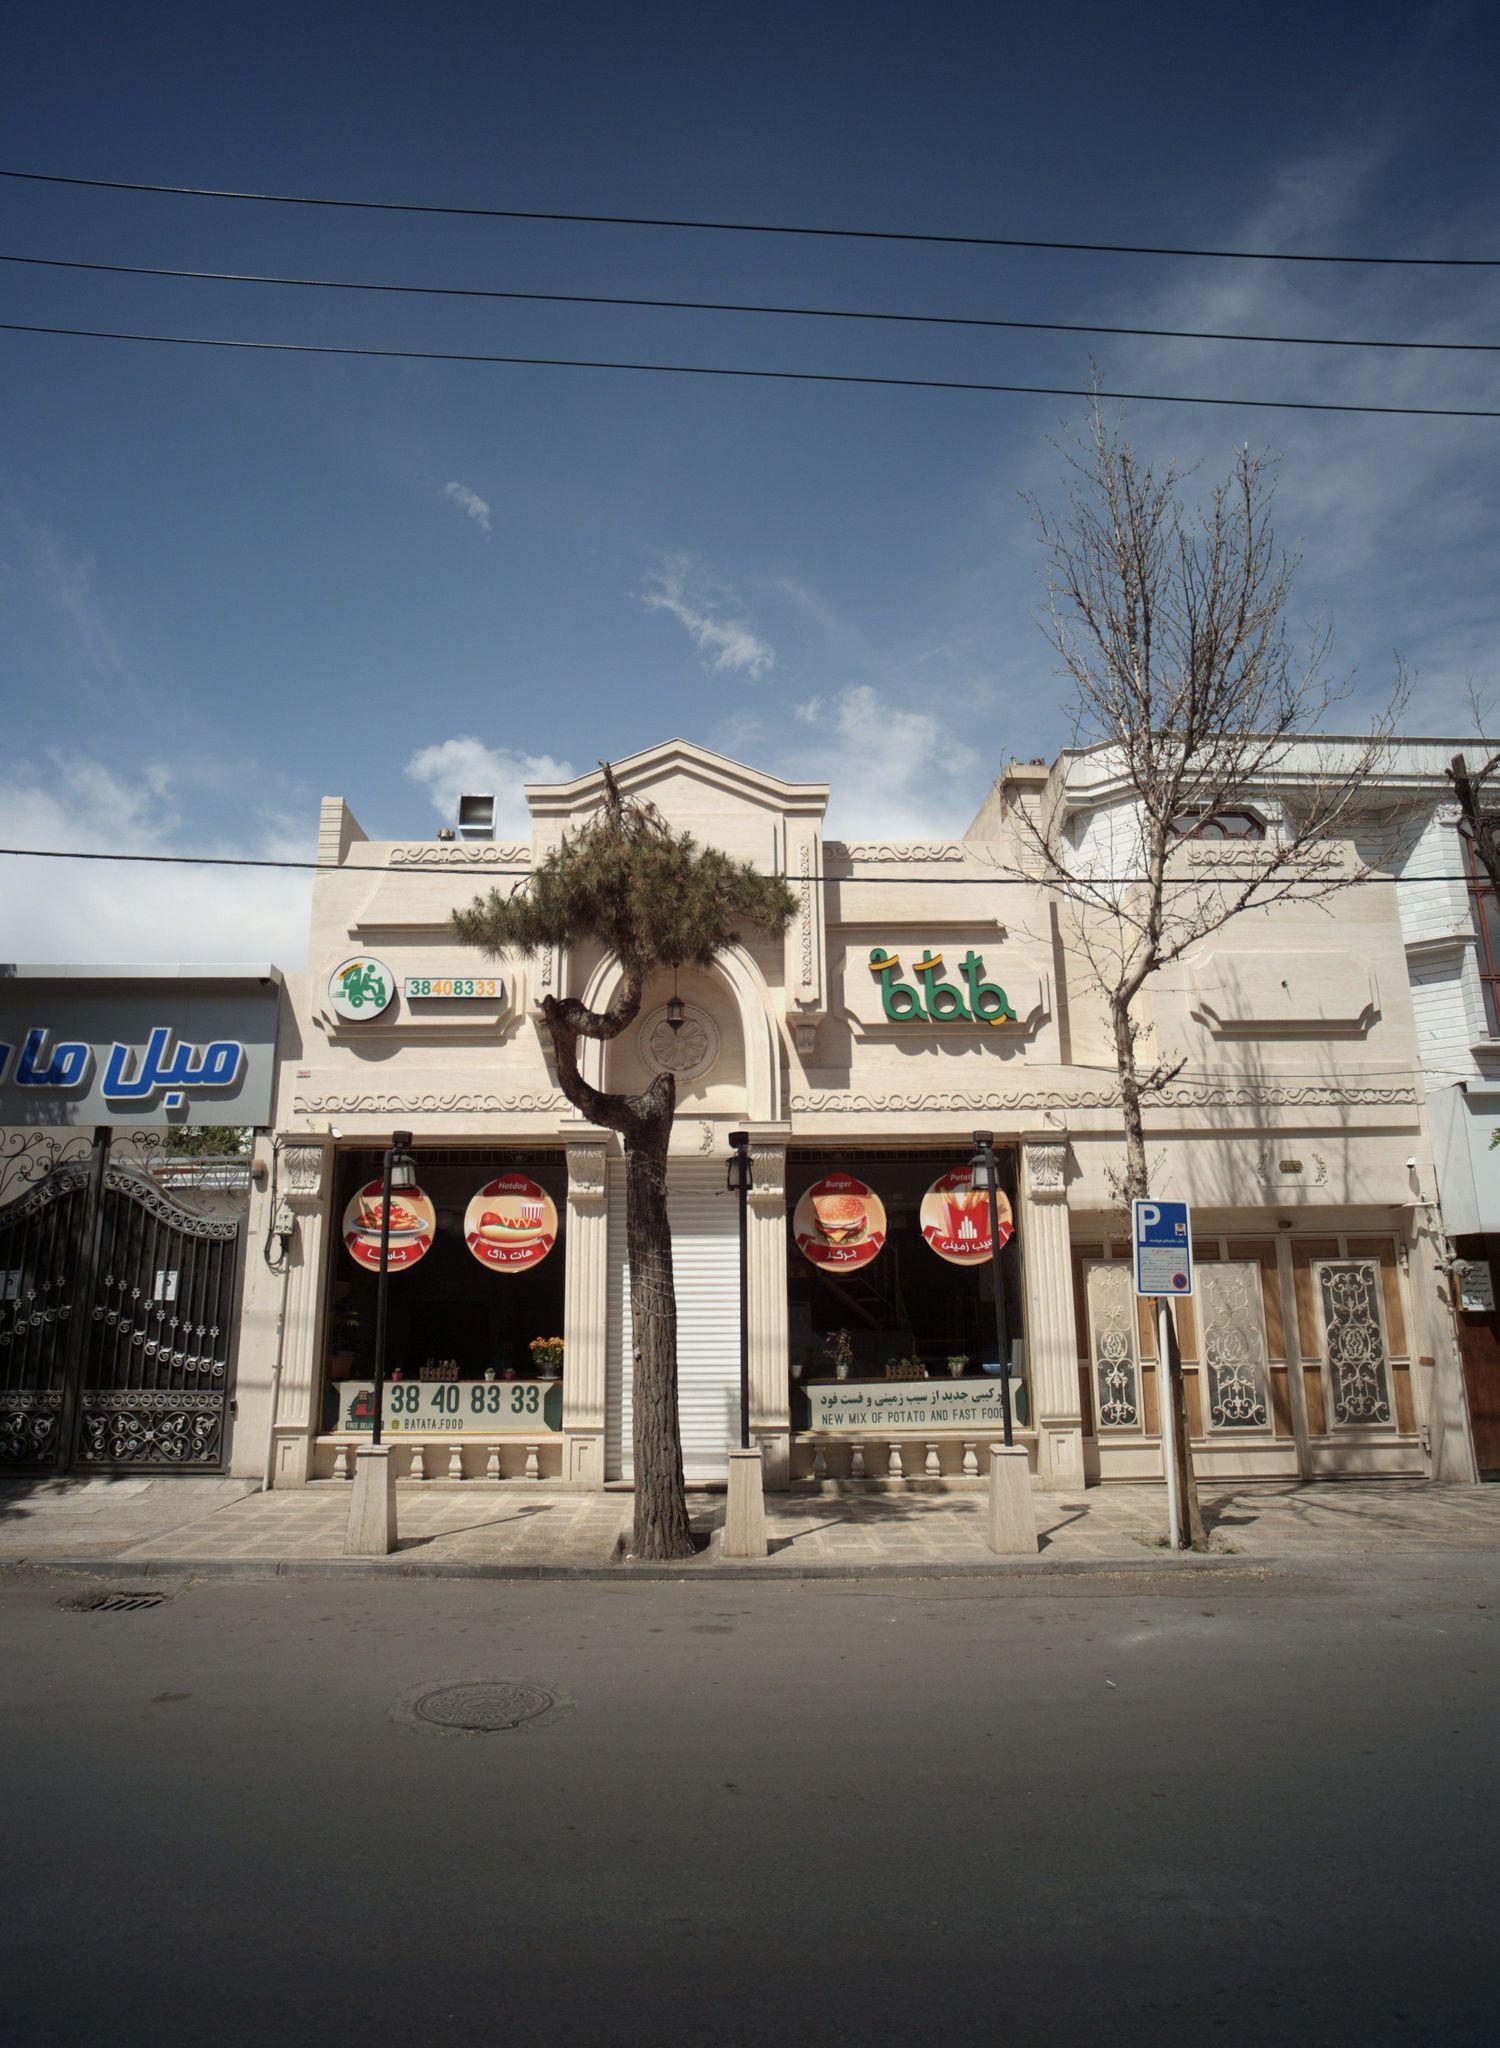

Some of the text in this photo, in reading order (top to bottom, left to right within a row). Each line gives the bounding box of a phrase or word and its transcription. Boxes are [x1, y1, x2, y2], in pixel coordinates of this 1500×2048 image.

[410, 980, 497, 996] 38408333
[102, 1027, 242, 1109] مبل
[498, 1181, 528, 1192] Hotdog
[825, 1179, 852, 1190] Burger
[1137, 1204, 1161, 1243] P
[941, 1240, 970, 1252] زمینی
[510, 1249, 533, 1260] هات
[391, 1384, 539, 1413] 38 40 83 33
[821, 1392, 838, 1408] فود
[840, 1392, 863, 1405] فست
[866, 1396, 872, 1407] و
[875, 1393, 904, 1406] زمینی
[906, 1393, 928, 1405] سیب
[930, 1390, 939, 1405] از
[942, 1391, 969, 1403] جدید
[822, 1412, 844, 1425] NEW
[848, 1412, 867, 1424] MIX
[871, 1411, 883, 1424] OF
[887, 1410, 925, 1423] POTATO
[930, 1409, 948, 1422] AND
[952, 1408, 977, 1421] FAST
